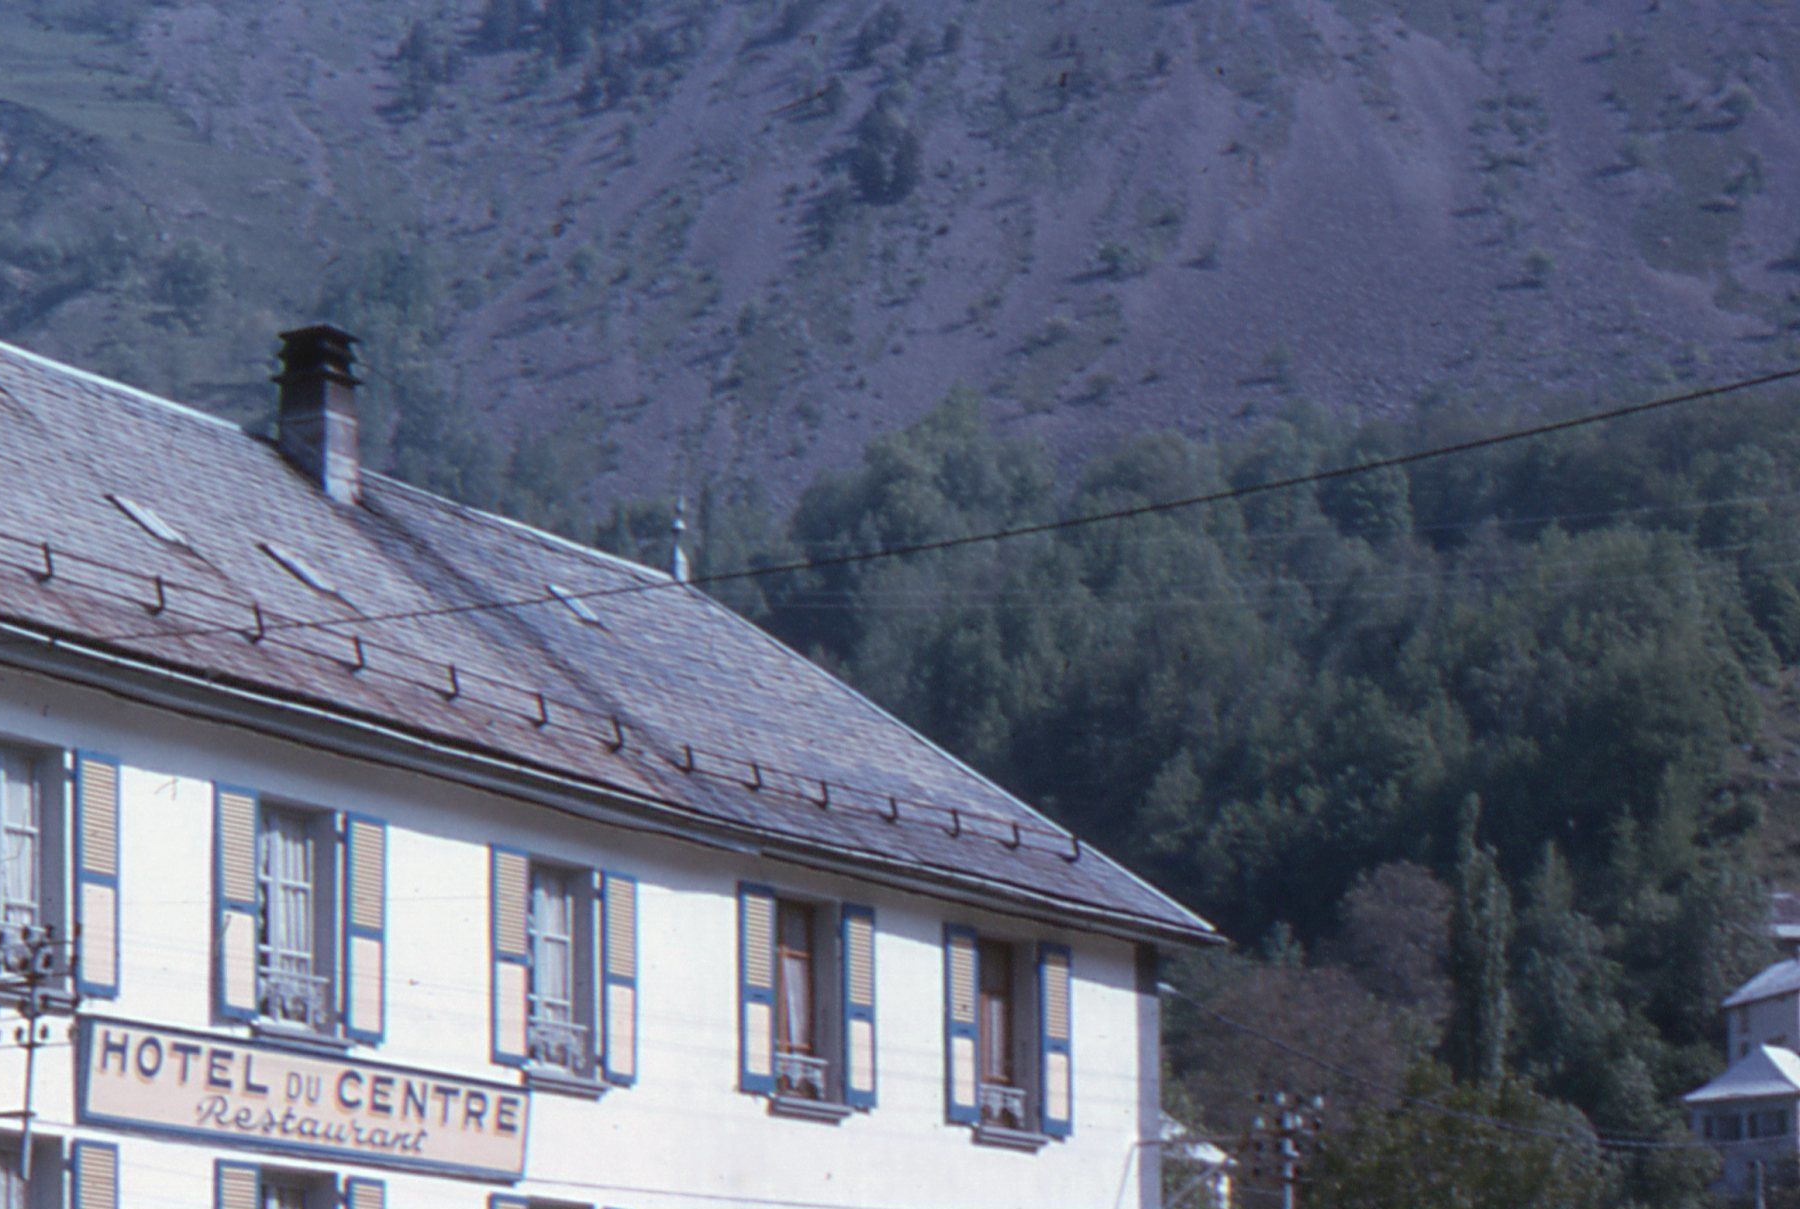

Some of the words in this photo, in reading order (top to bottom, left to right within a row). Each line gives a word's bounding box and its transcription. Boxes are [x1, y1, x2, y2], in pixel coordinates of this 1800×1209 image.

[98, 1030, 270, 1095] HOTEL
[284, 1071, 323, 1106] DU
[335, 1070, 521, 1134] CENTRE
[196, 1095, 429, 1155] Restaurant
